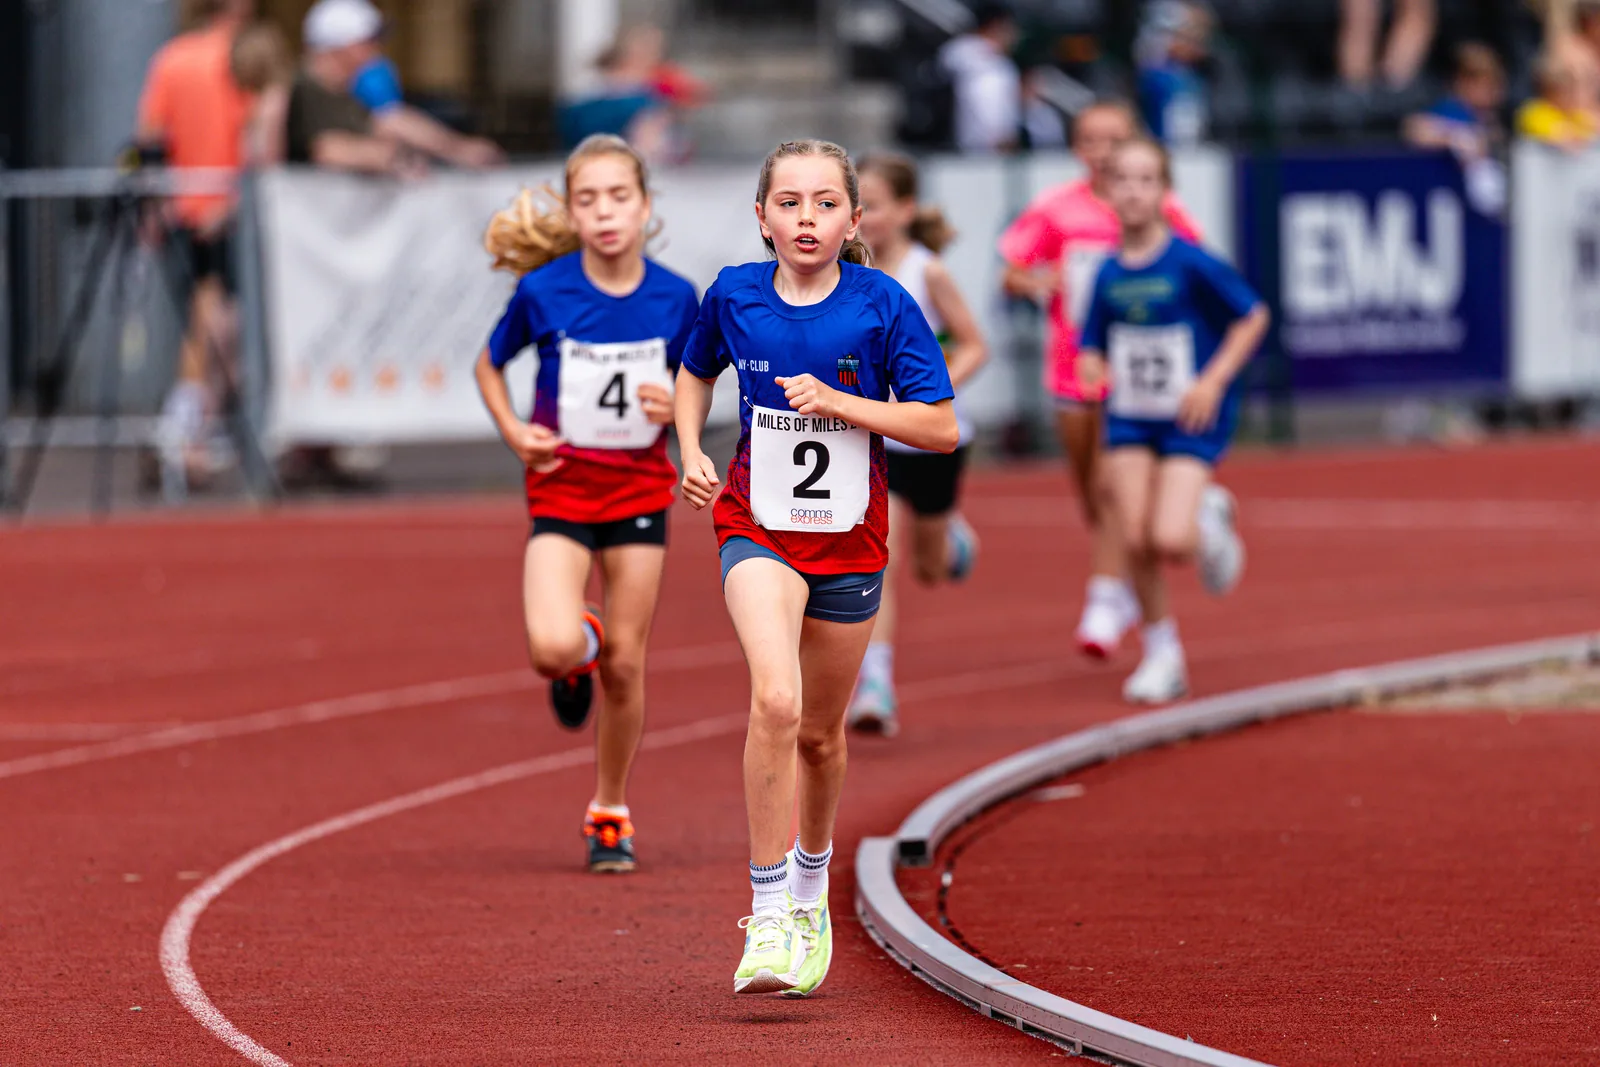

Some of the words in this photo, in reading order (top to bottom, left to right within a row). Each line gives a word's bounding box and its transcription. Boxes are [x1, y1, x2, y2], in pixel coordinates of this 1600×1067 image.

[598, 370, 629, 419] 4
[757, 412, 791, 432] MILES
[794, 417, 809, 432] OF
[811, 416, 848, 433] MILES
[792, 440, 831, 500] 2
[790, 508, 833, 518] comms
[790, 515, 833, 525] express
